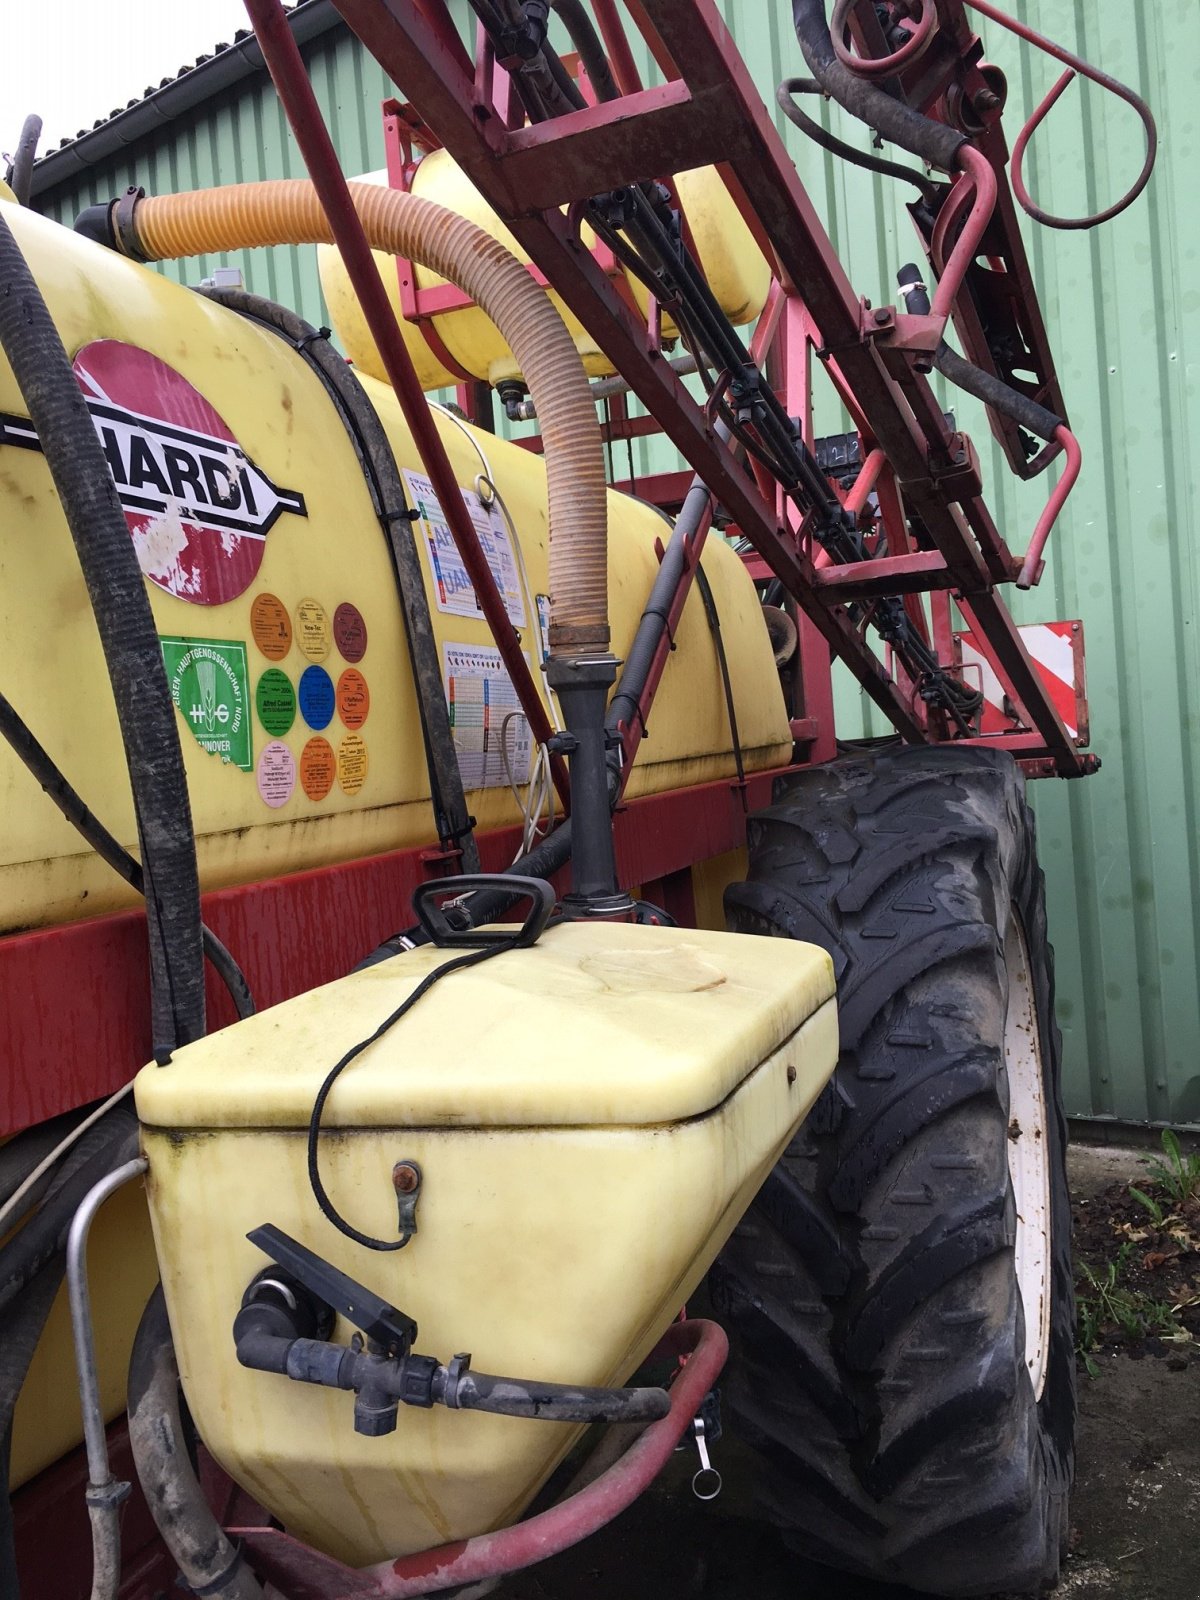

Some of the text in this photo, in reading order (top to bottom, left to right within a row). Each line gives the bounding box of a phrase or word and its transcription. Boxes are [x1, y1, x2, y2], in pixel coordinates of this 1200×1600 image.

[101, 426, 258, 517] HARDI
[176, 647, 242, 703] HAUPTGENOSSENSCHAFT
[231, 706, 242, 733] NORD
